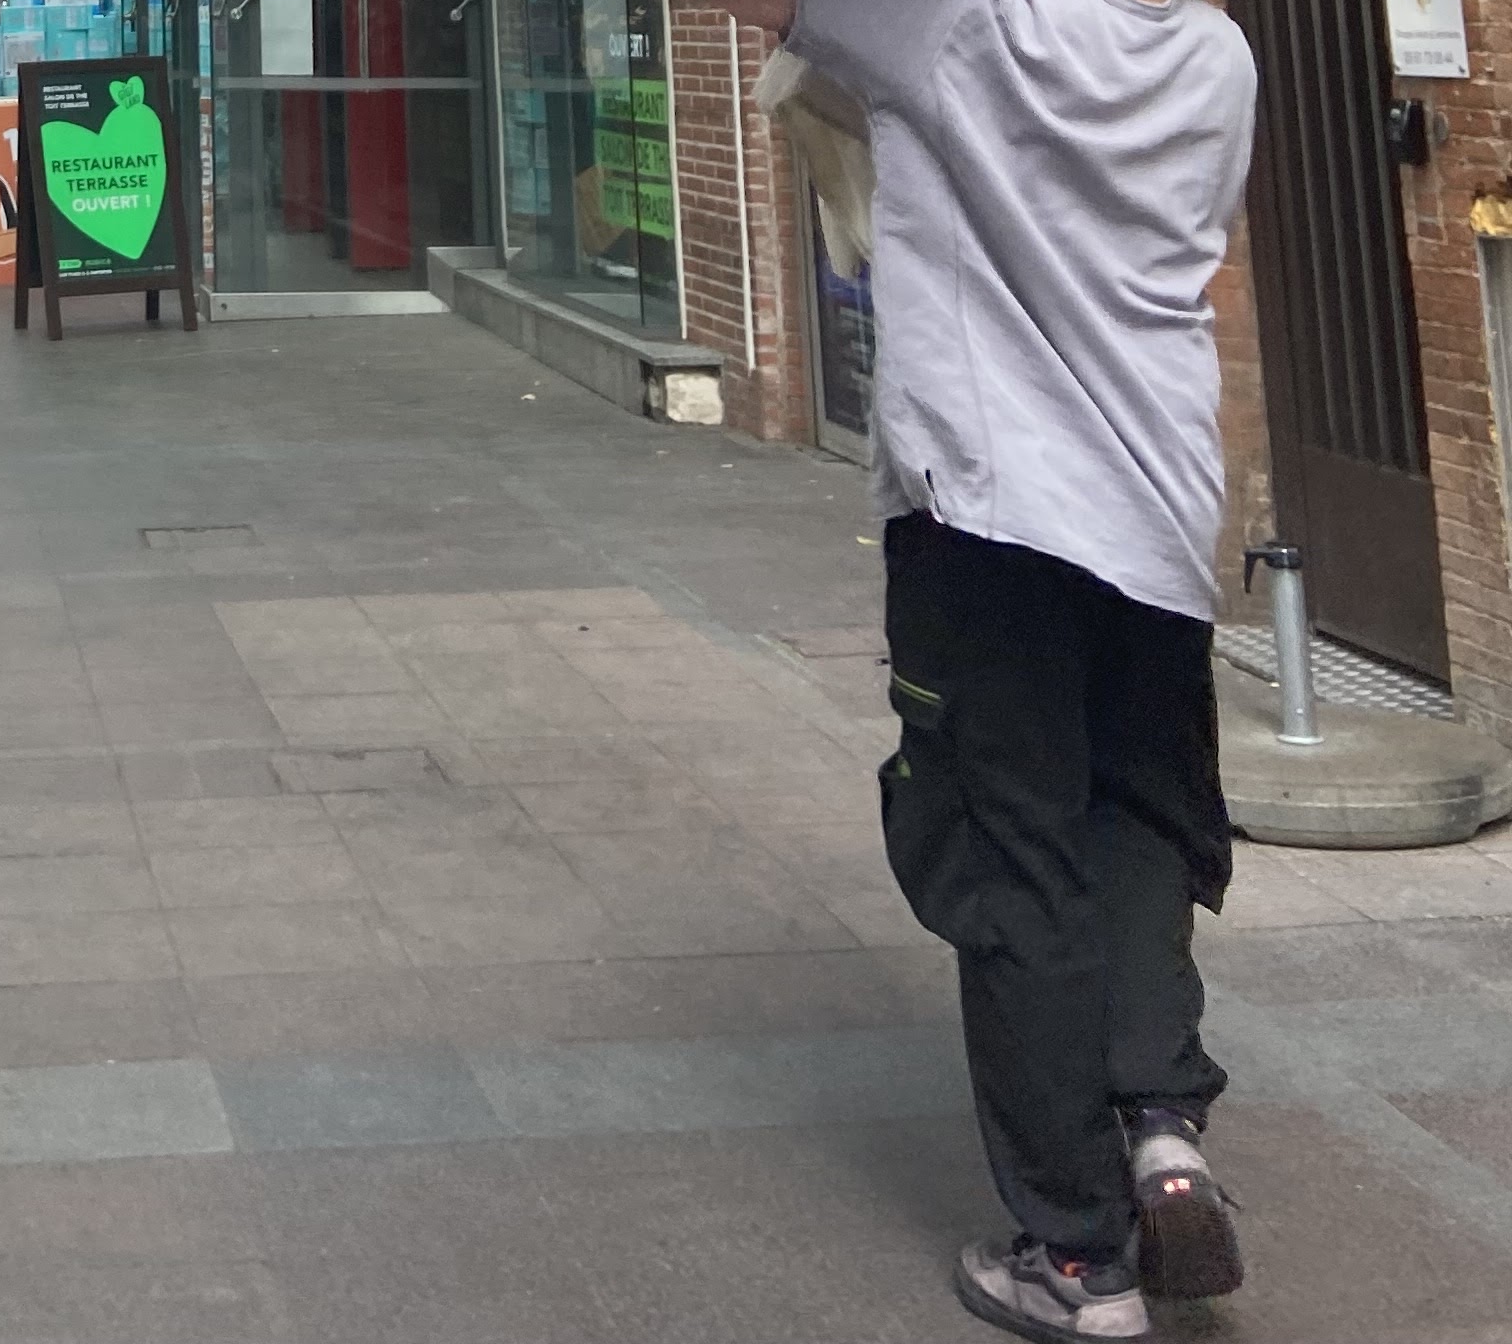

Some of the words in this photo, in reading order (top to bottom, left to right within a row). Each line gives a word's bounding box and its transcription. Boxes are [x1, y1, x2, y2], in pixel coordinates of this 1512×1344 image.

[51, 154, 158, 173] RESTAURANT
[66, 174, 148, 192] TERRASSE
[72, 194, 139, 212] OUVERT
